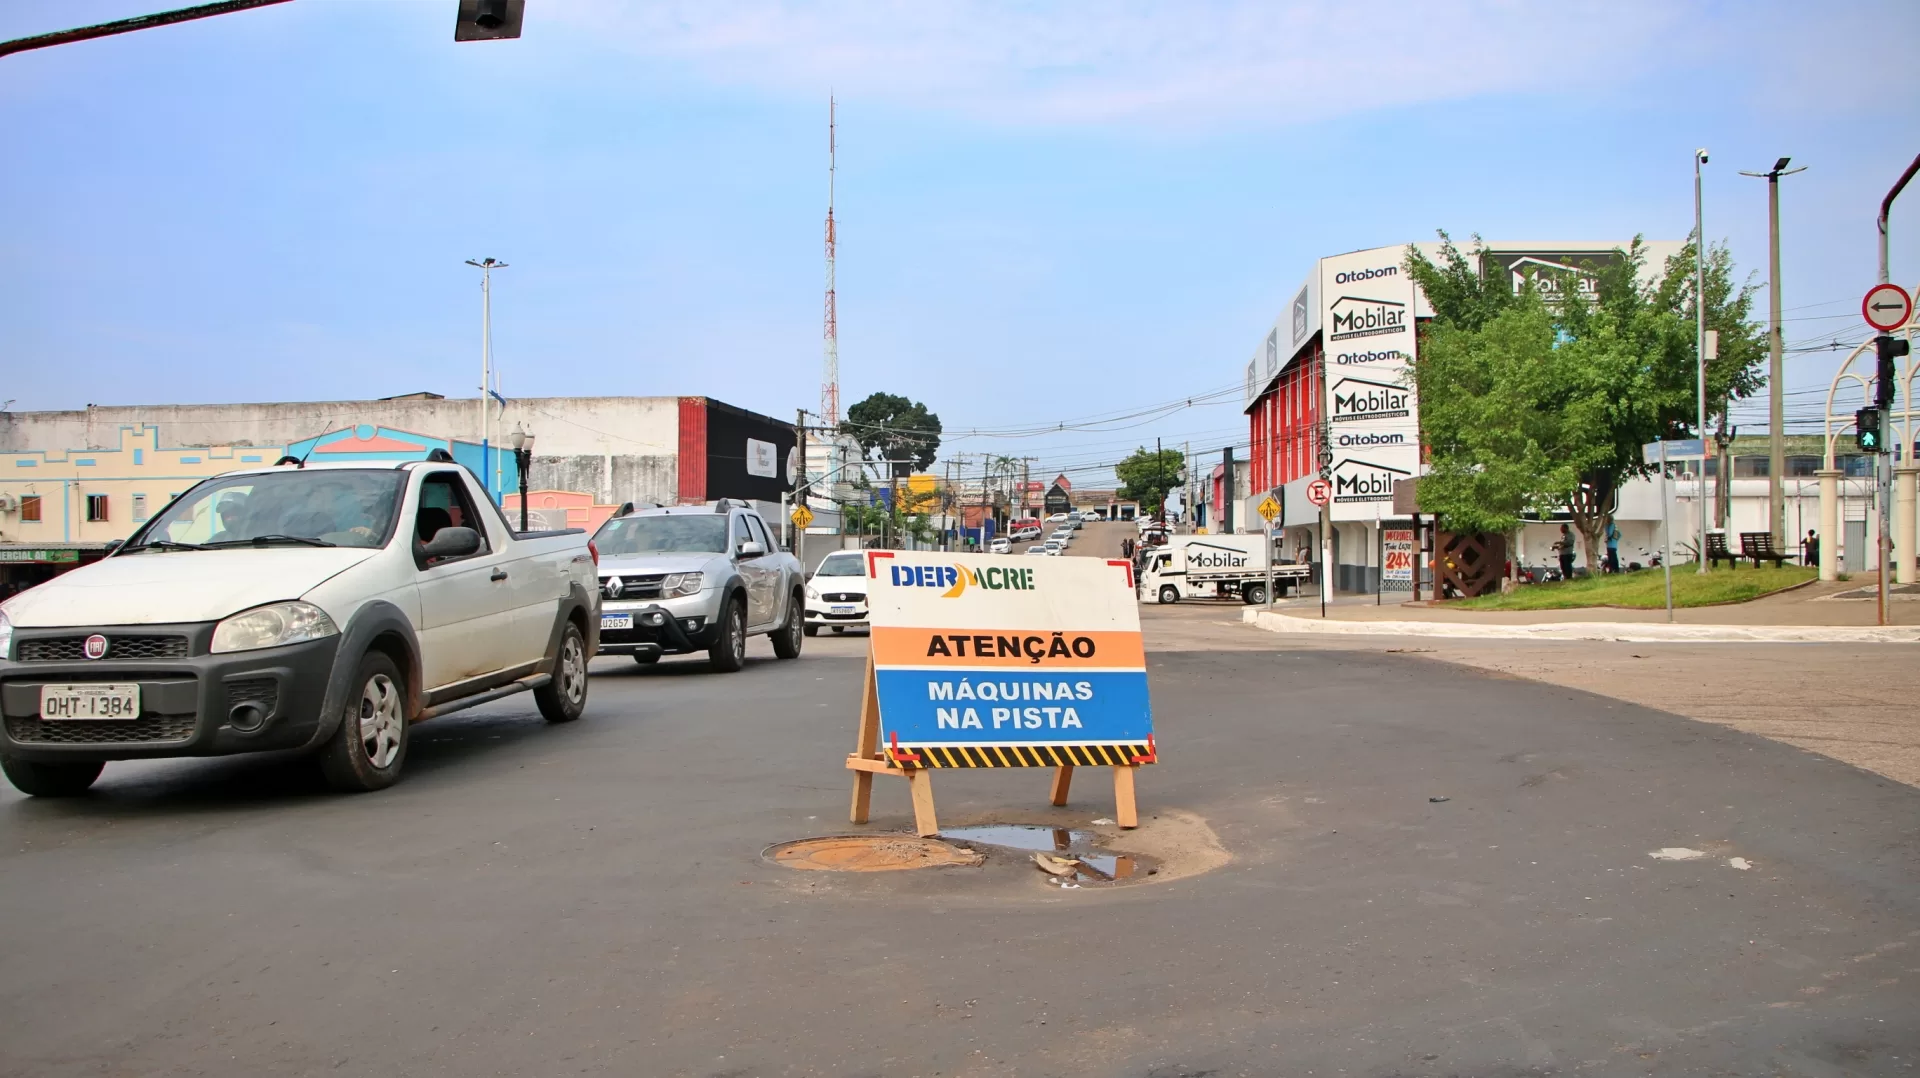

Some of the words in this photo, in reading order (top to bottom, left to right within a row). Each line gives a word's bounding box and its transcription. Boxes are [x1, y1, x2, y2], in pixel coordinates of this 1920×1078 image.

[1336, 266, 1397, 284] Ortobom
[1513, 270, 1599, 293] Moar
[1333, 305, 1405, 333] Mobilar
[1337, 350, 1400, 365] Ortobom
[1335, 389, 1408, 414] Mobilar
[1339, 433, 1403, 446] Ortobom
[1337, 472, 1400, 495] Mobil
[0, 551, 33, 560] ERCIAL
[1187, 552, 1248, 567] Mobilar
[1386, 551, 1411, 569] 24X
[891, 565, 958, 588] DER
[600, 618, 629, 628] U2G57
[89, 641, 104, 653] FIAT
[927, 632, 1096, 664] ATENÇÃO
[928, 678, 1093, 701] MÁQUINAS
[936, 707, 983, 729] NA
[991, 707, 1083, 729] PISTA
